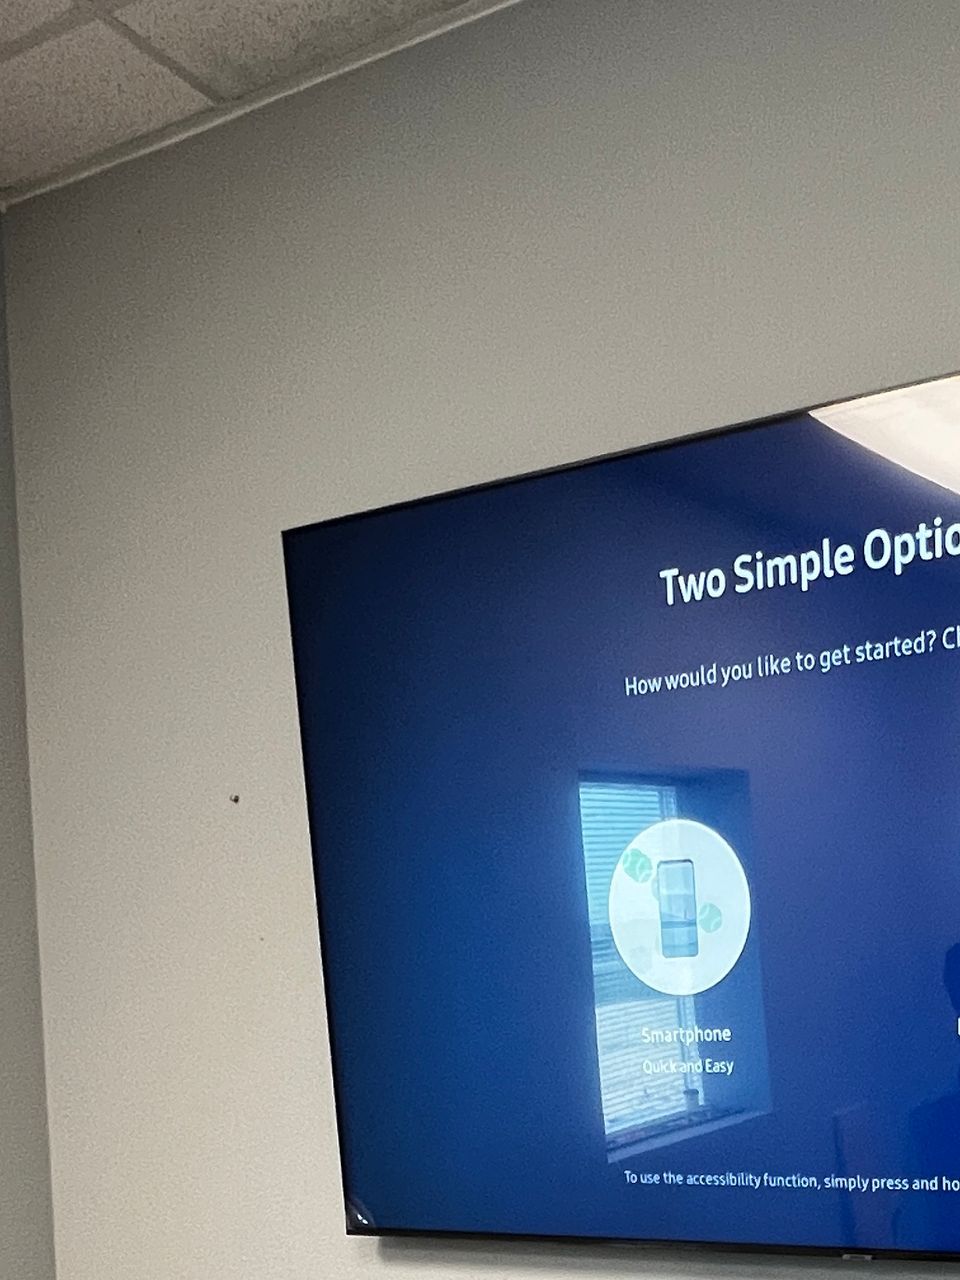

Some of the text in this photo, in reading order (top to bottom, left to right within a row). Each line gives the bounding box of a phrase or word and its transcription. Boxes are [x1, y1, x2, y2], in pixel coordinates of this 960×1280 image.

[659, 566, 726, 605] Two
[733, 538, 855, 594] Simple
[624, 676, 662, 696] How
[665, 664, 717, 690] would
[721, 661, 753, 687] you
[757, 654, 791, 677] like
[795, 651, 815, 672] to
[819, 644, 851, 673] get
[855, 630, 937, 664] started?
[641, 1026, 732, 1046] Smartphone
[642, 1058, 734, 1076] Quick and Easy
[624, 1170, 637, 1184] To
[640, 1173, 661, 1185] use
[663, 1172, 683, 1185] the
[686, 1172, 761, 1190] accessibility
[763, 1173, 821, 1191] function,
[824, 1174, 869, 1193] simply
[871, 1178, 909, 1194] press
[912, 1176, 938, 1192] and
